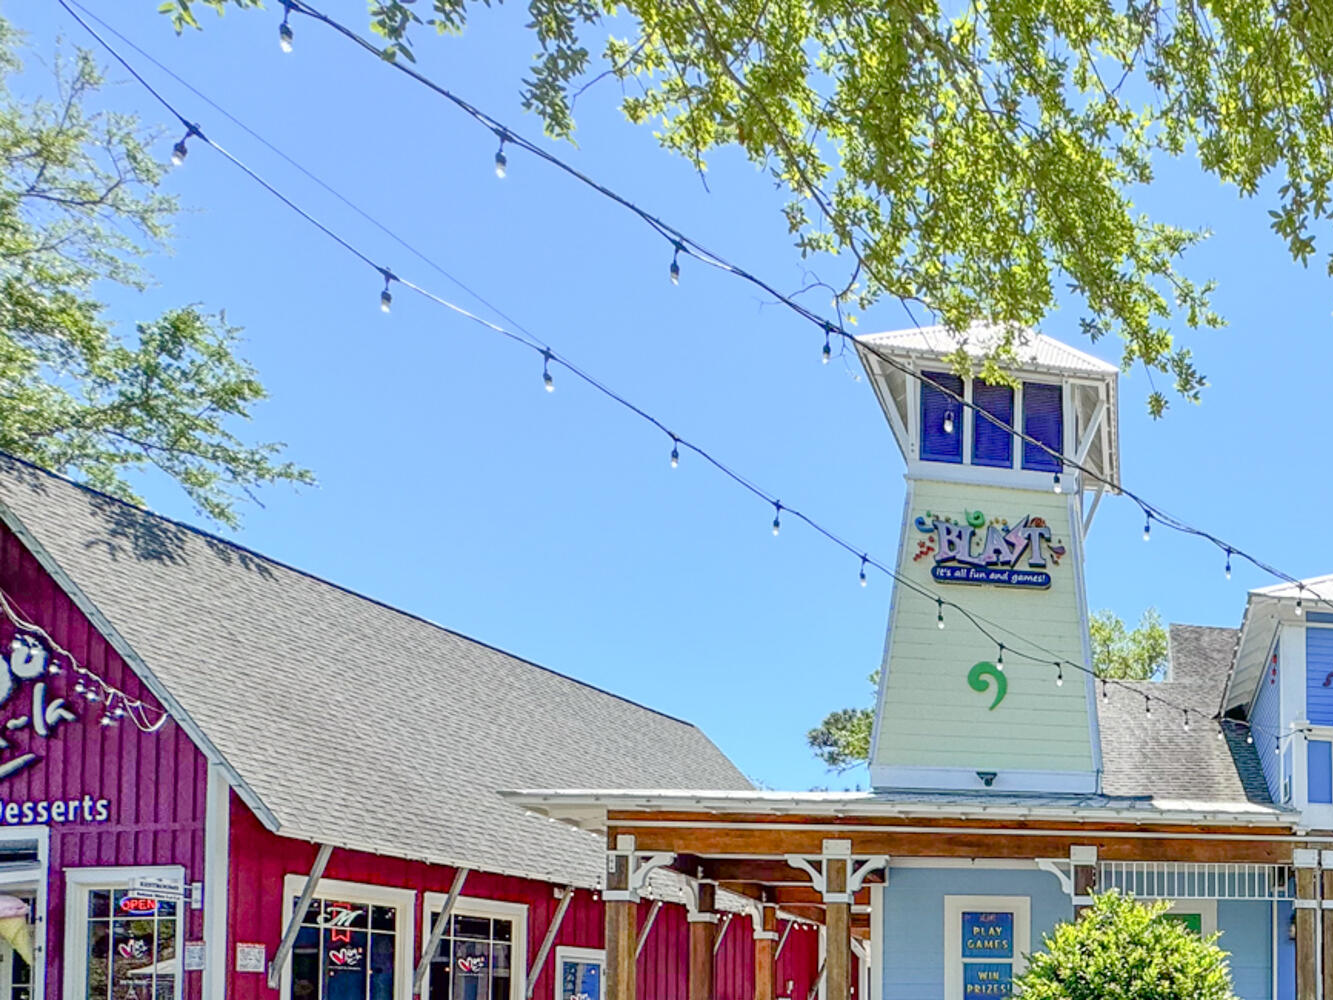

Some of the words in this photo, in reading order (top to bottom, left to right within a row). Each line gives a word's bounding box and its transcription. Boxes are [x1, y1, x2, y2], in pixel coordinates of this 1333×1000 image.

[932, 514, 1051, 568] BLAST
[936, 568, 951, 577] It's
[954, 569, 967, 577] all
[970, 569, 987, 579] fun
[989, 572, 1009, 580] and
[1011, 574, 1046, 584] games!
[0, 794, 108, 824] esserts
[121, 899, 156, 911] OPEN
[973, 926, 1002, 936] PLAY
[967, 940, 1009, 950] GAMES
[978, 971, 999, 981] WIN
[966, 984, 1011, 994] PRIZES!
